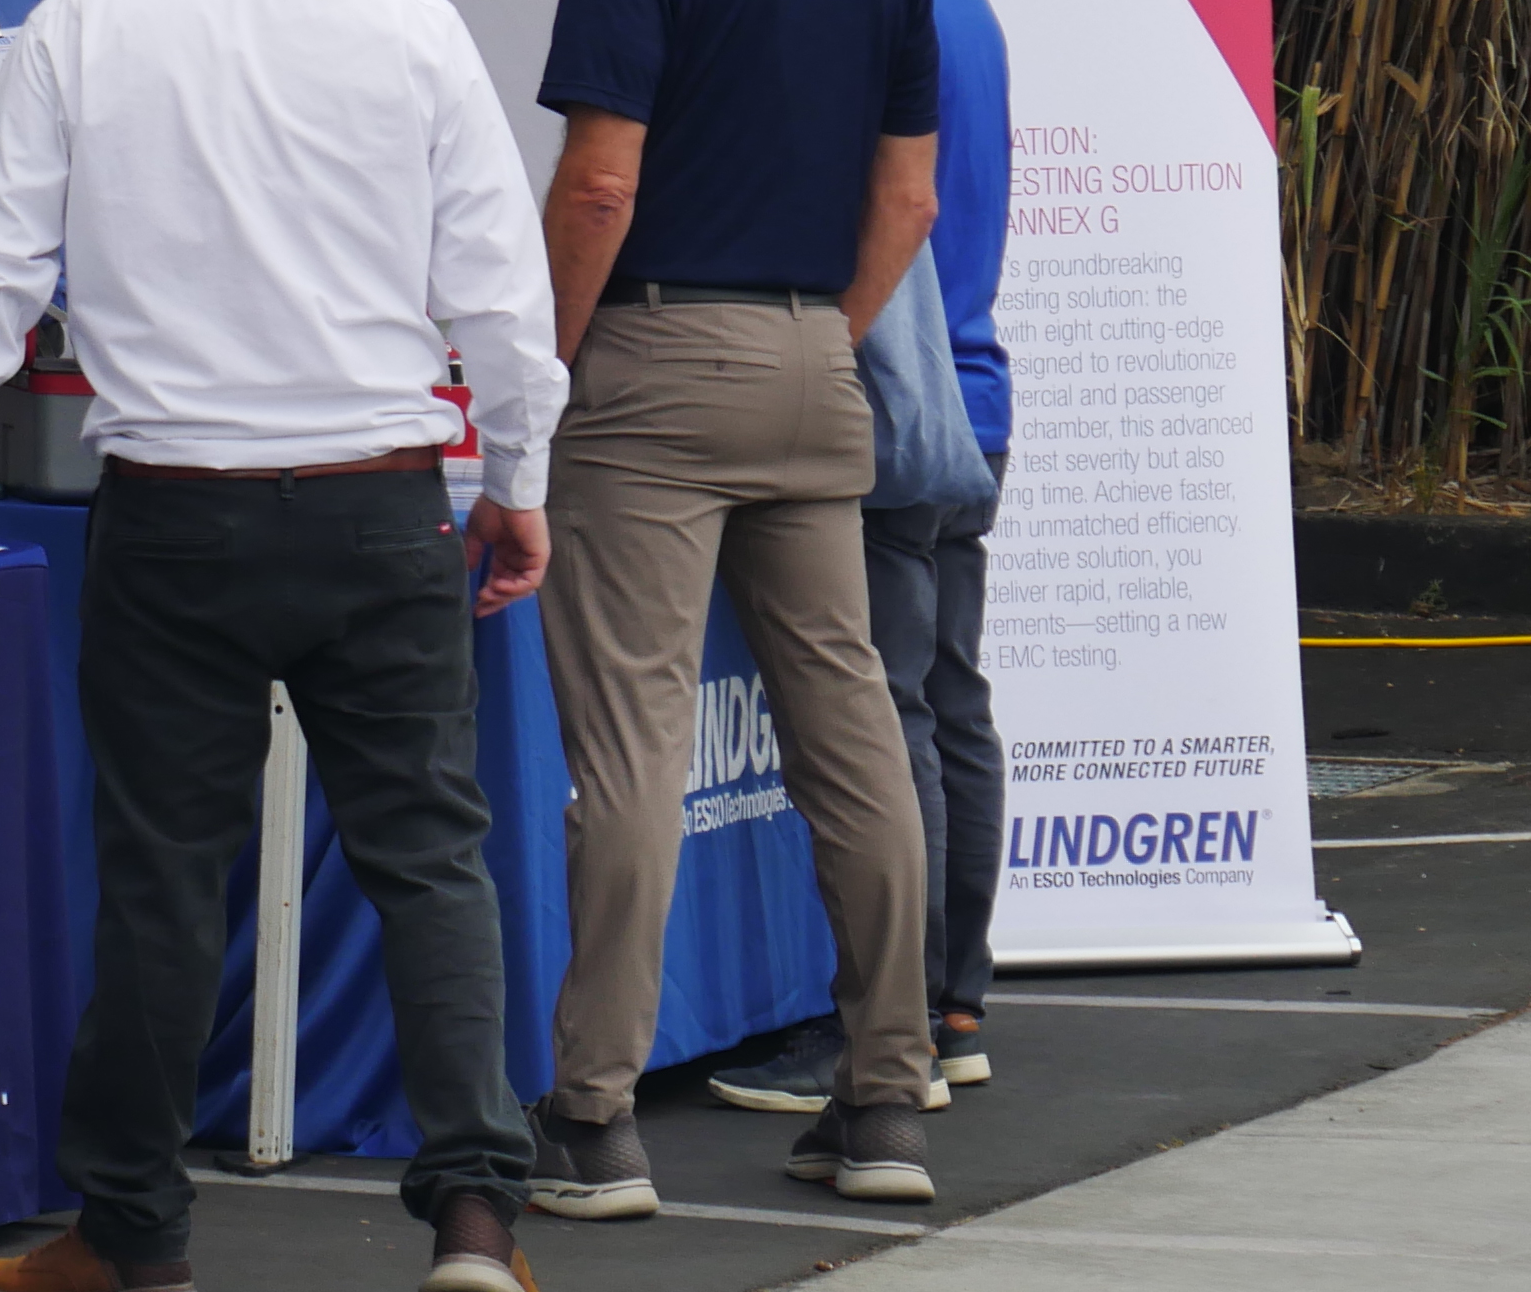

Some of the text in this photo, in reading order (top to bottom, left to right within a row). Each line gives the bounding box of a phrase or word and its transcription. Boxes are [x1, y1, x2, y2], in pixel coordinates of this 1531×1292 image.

[1012, 126, 1099, 156] ATION:
[1010, 162, 1244, 196] ESTING SOLUTION
[1100, 205, 1119, 234] G
[1028, 251, 1184, 283] groundbreaking
[1067, 285, 1150, 311] solution:
[1157, 284, 1189, 307] the
[998, 315, 1225, 347] with eight cutting-edge
[1009, 348, 1238, 380] esigned to revolutionize
[1080, 383, 1118, 406] and
[1124, 384, 1227, 411] passenger
[1022, 411, 1254, 441] chamber, this advanced
[1023, 450, 1060, 473] test
[1065, 446, 1140, 474] severity
[1147, 446, 1181, 470] but
[1186, 445, 1225, 468] also
[1000, 477, 1237, 511] ting time. Achieve faster,
[1029, 512, 1139, 538] unmatched
[1147, 511, 1243, 539] efficiency.
[986, 544, 1202, 573] novative solution, you
[986, 575, 1193, 606] deliver rapid, reliable,
[1168, 612, 1181, 632] a
[1187, 610, 1228, 632] new
[999, 644, 1046, 670] EMC
[1052, 644, 1122, 671] testing.
[1011, 734, 1276, 761] COMMITTED TO A SMARTER,
[1011, 756, 1266, 783] MORE CONNECTED FUTURE
[693, 793, 724, 834] ESCO
[1009, 867, 1254, 890] An ESCO Technologies Company
